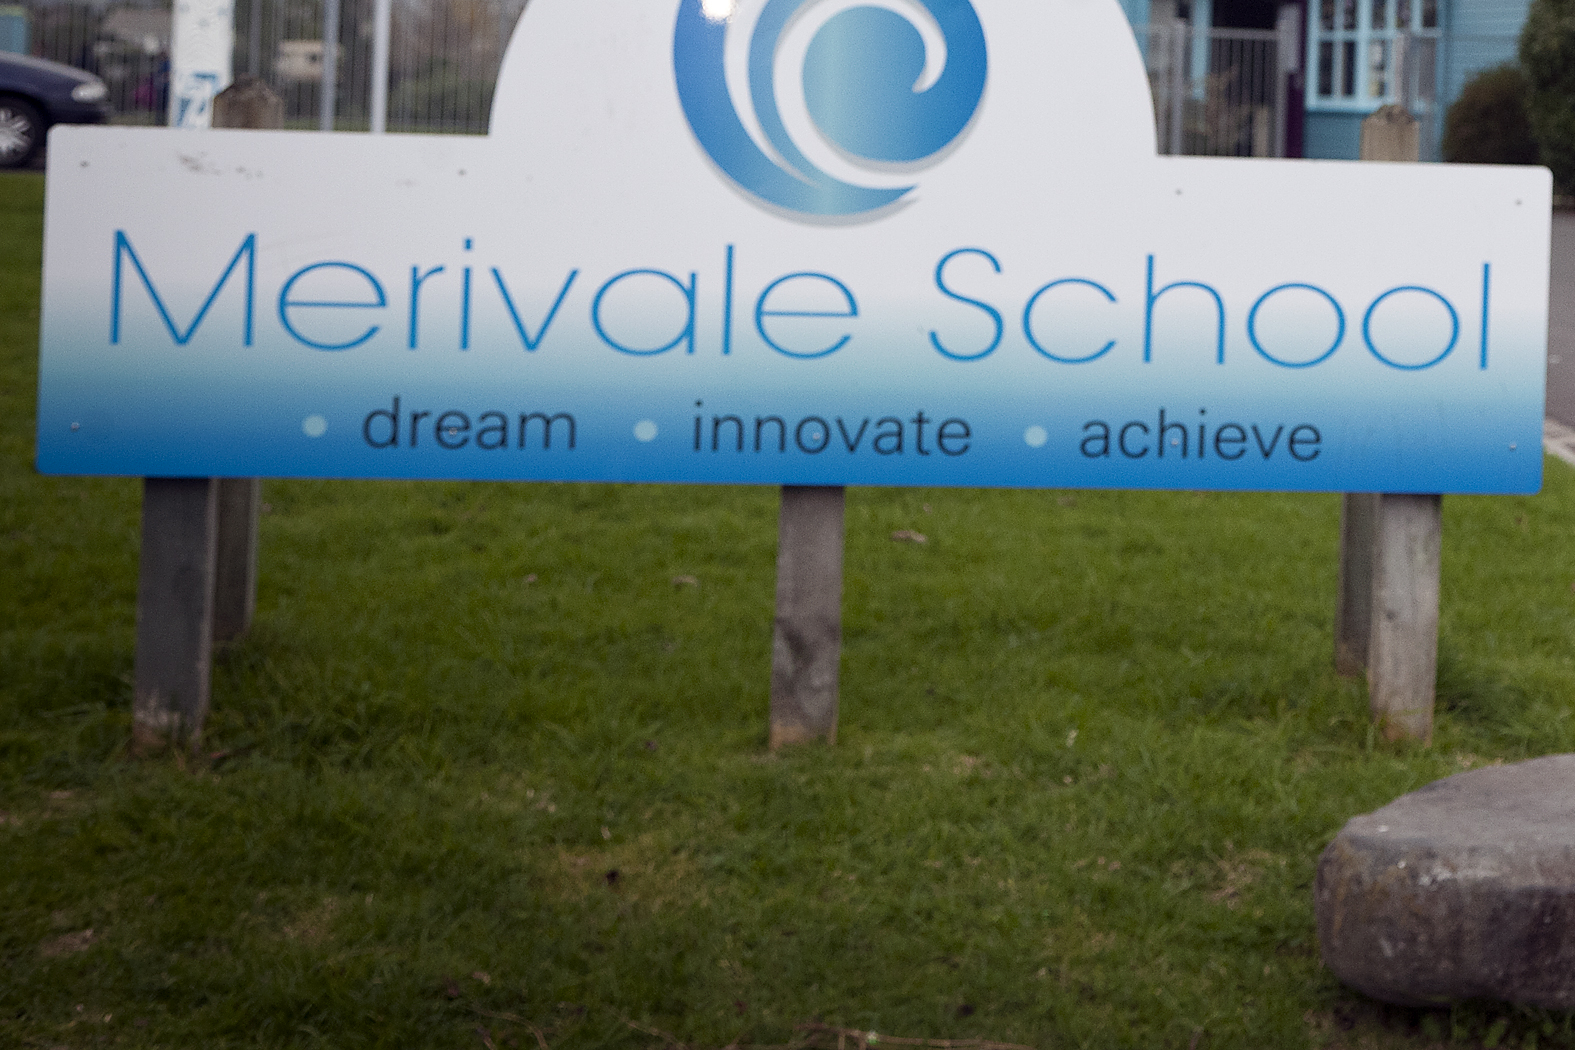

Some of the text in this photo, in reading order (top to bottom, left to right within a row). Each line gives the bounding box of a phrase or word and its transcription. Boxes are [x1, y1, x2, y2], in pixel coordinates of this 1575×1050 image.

[110, 229, 1491, 371] Merivale School
[362, 396, 1323, 461] dream innovate achieve
